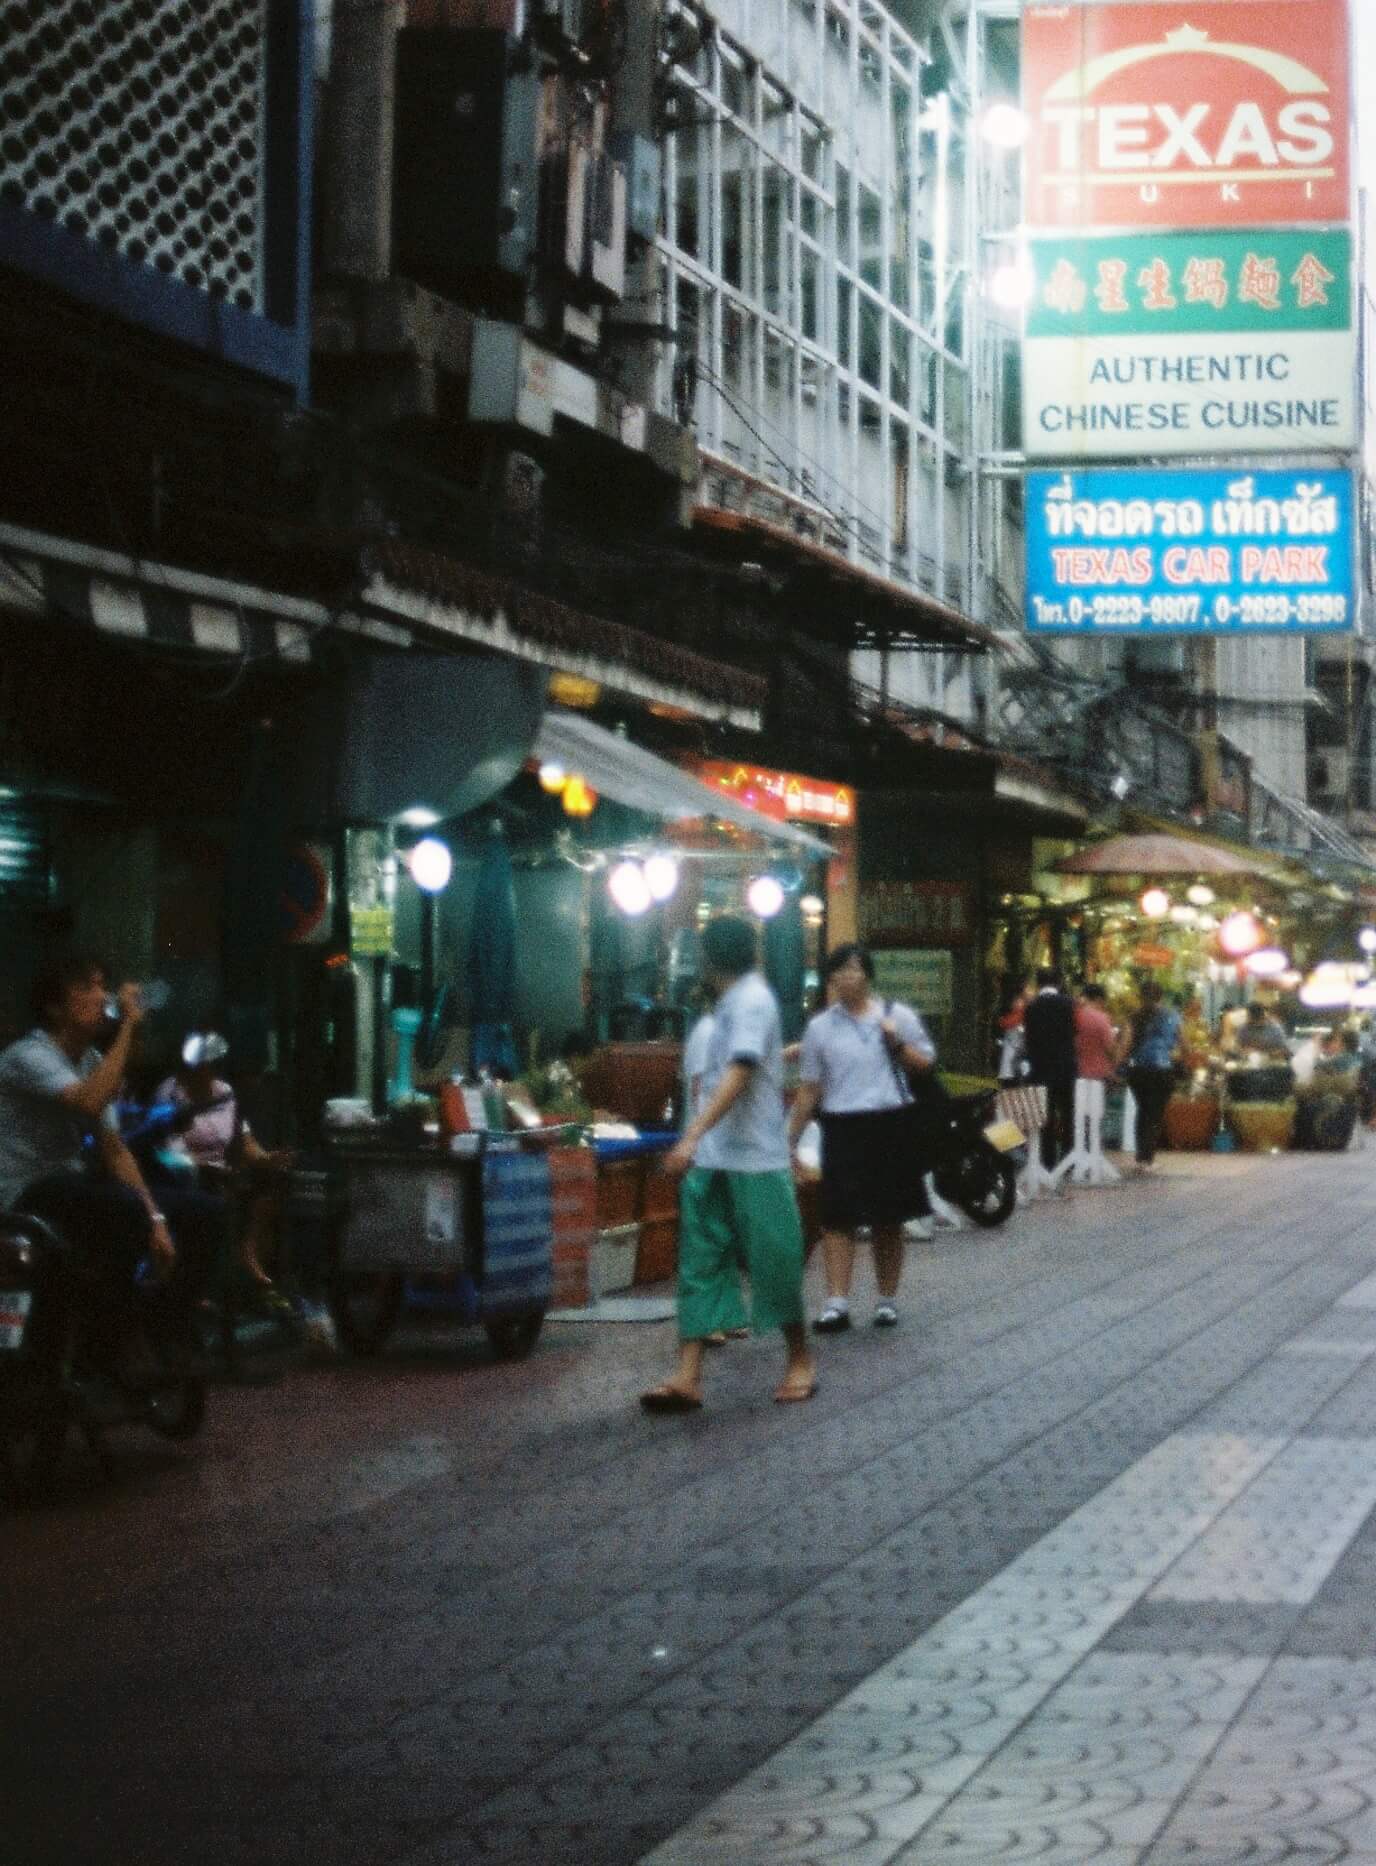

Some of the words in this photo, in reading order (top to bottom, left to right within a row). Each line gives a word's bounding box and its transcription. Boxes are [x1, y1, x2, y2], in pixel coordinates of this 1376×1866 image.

[1041, 102, 1334, 168] TEXAS
[1060, 181, 1315, 206] SUKI
[1090, 353, 1290, 385] AUTHENTIC
[1039, 402, 1191, 433] CHINESE
[1201, 398, 1340, 429] CUISINE
[1045, 474, 1204, 537] ที่จอดรถ
[1052, 547, 1153, 585] TEXAS
[1163, 547, 1231, 584] CAR
[1241, 546, 1329, 584] PARK
